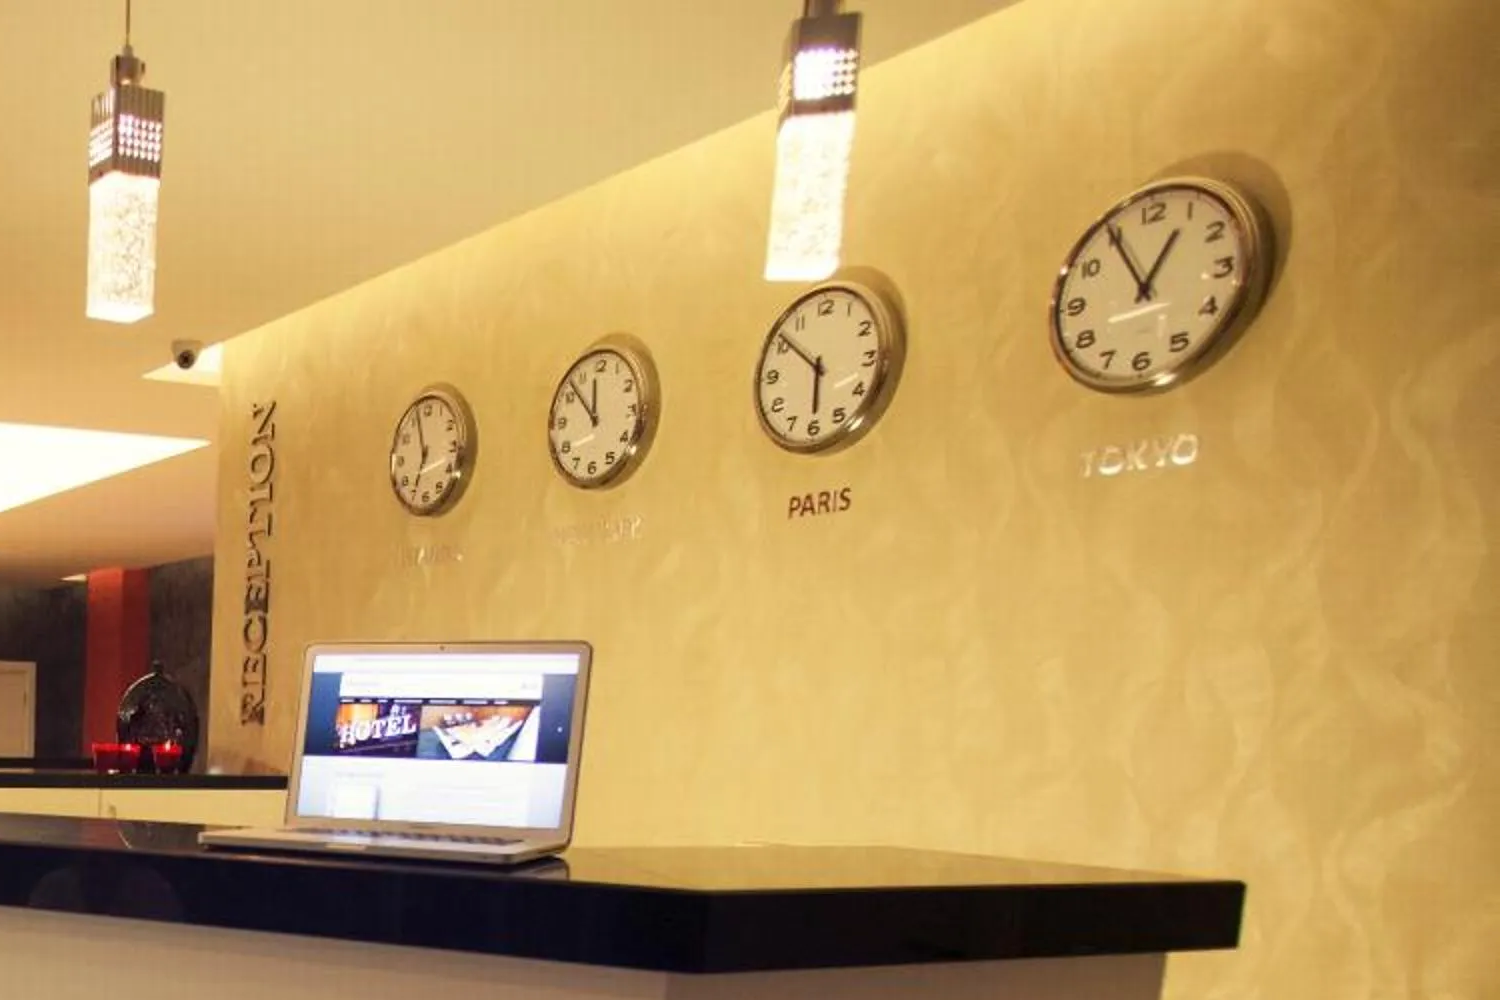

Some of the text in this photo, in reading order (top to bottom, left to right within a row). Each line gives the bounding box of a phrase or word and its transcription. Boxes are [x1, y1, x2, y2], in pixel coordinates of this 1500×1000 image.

[1141, 202, 1166, 225] 12
[1187, 201, 1192, 220] 1
[1205, 220, 1224, 243] 2
[1082, 260, 1100, 279] 10
[1213, 256, 1233, 278] 3
[817, 300, 835, 317] 12
[1067, 297, 1086, 316] 9
[1199, 296, 1218, 316] 4
[858, 320, 871, 337] 2
[1076, 330, 1095, 349] 8
[1169, 332, 1189, 352] 5
[861, 350, 876, 367] 3
[1100, 350, 1116, 369] 7
[1132, 351, 1151, 371] 6
[767, 370, 779, 385] 9
[852, 381, 865, 396] 4
[786, 415, 798, 431] 7
[832, 408, 846, 424] 5
[807, 420, 820, 436] 6
[605, 451, 615, 465] 5
[1079, 432, 1198, 478] TOKYO
[587, 460, 597, 475] 6
[788, 488, 852, 519] PARIS
[240, 401, 277, 727] RECEPTION
[338, 714, 417, 748] HOTEL
